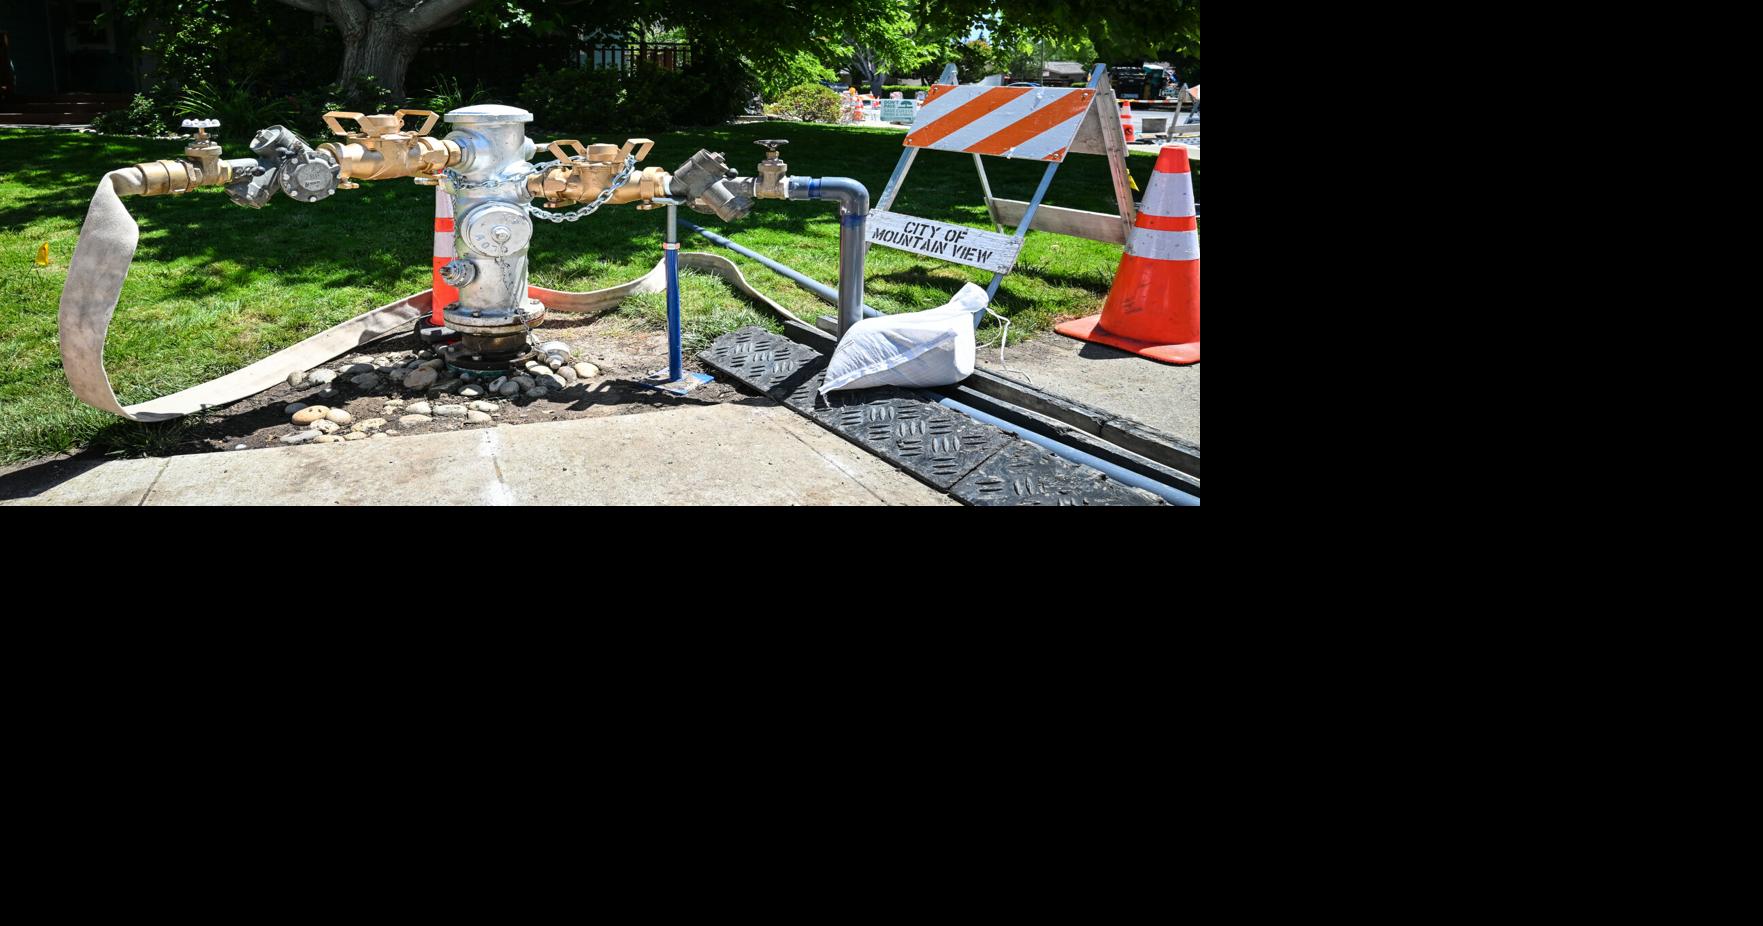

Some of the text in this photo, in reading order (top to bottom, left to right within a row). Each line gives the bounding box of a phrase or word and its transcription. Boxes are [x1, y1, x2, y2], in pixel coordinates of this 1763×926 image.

[872, 227, 993, 263] MOUNTAIN VIEW
[904, 221, 968, 243] CITY OF
